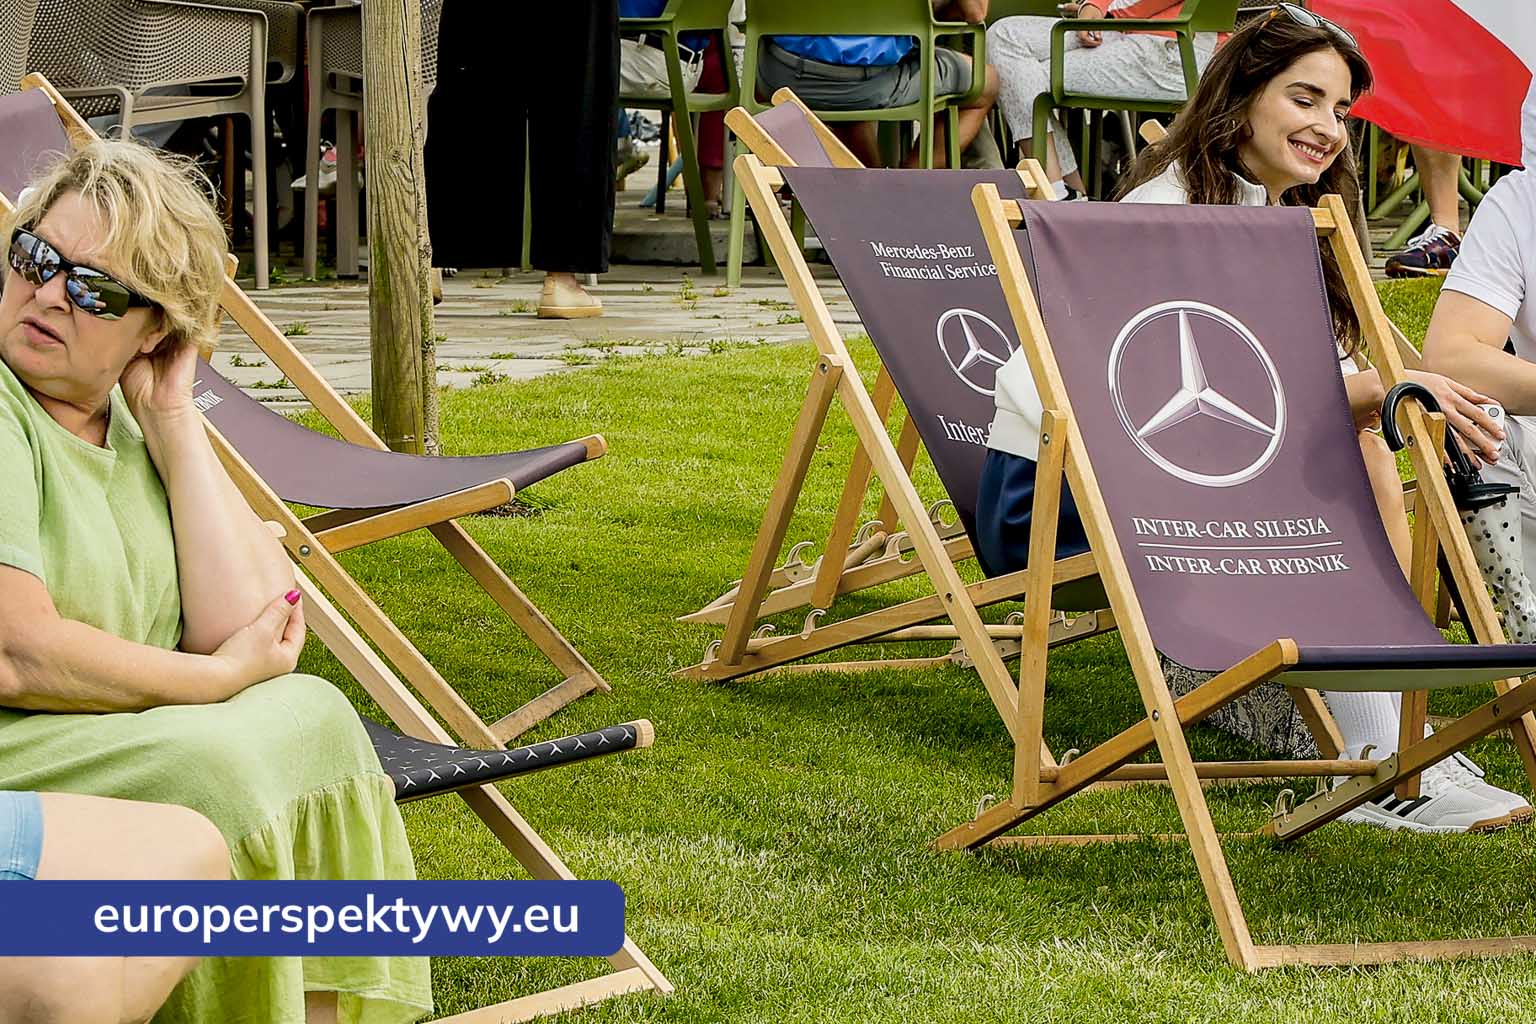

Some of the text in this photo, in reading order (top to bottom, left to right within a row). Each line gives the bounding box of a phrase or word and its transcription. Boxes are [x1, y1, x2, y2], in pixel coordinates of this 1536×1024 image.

[869, 241, 976, 261] Mercedes-Benz
[879, 261, 998, 281] Financial Service
[936, 414, 994, 447] Inter-
[1131, 516, 1333, 539] INTER-CAR SILESIA
[1144, 553, 1351, 576] INTER-CAR RYBNIK
